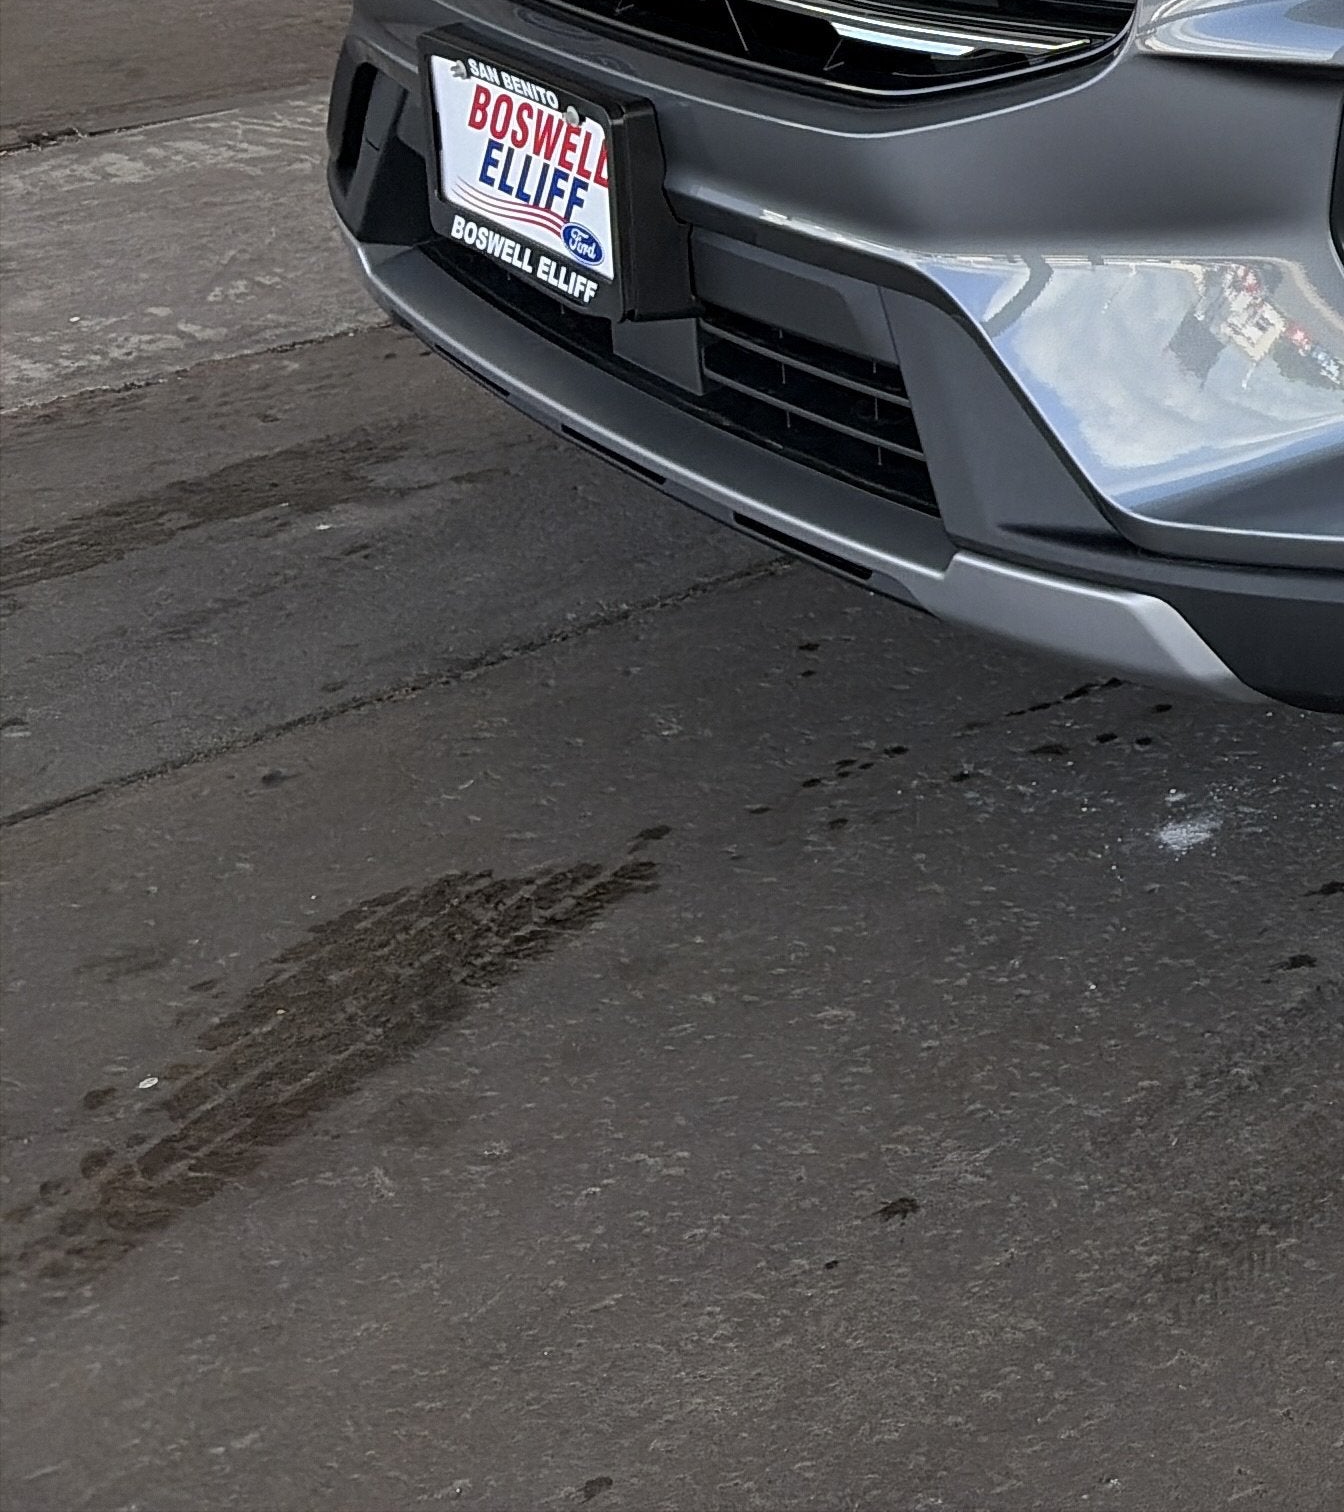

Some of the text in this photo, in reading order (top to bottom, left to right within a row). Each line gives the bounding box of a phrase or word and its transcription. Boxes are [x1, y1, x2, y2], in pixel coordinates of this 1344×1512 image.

[467, 58, 560, 109] SAN BENITO
[467, 83, 610, 189] BOSWELL
[478, 138, 590, 223] ELLIFF
[451, 215, 599, 304] BOSWELL ELLIFF
[567, 230, 598, 260] Ford
